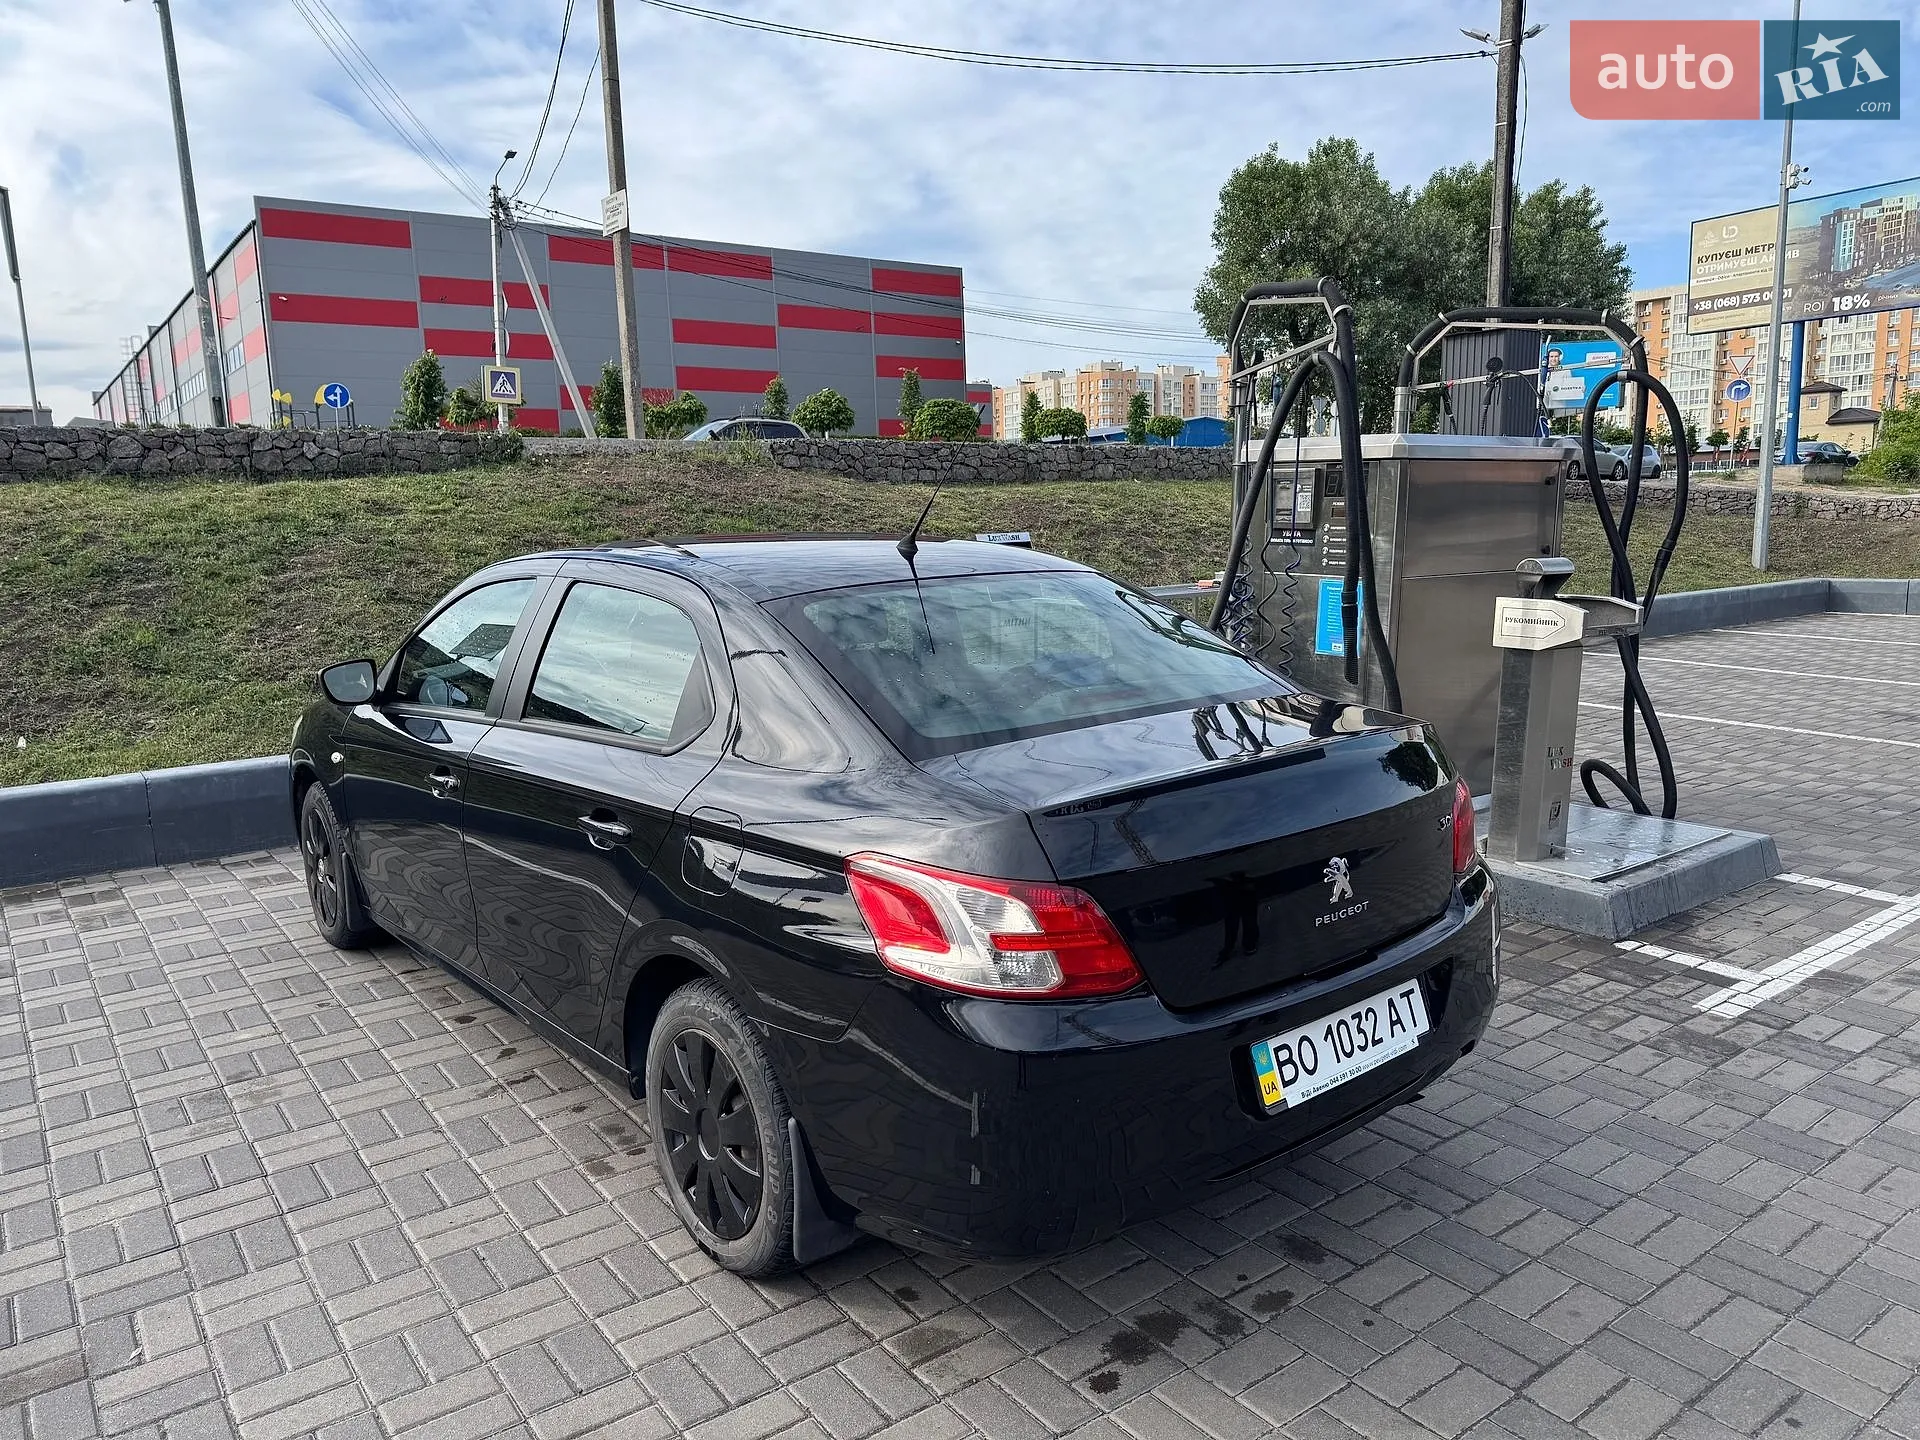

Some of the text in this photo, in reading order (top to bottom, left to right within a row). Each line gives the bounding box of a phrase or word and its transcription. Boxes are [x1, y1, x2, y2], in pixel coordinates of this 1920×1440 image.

[1696, 249, 1800, 275] ОТРИМУЄШ АКИВ
[1697, 243, 1776, 264] КУПУЄШ МЕТР
[1694, 300, 1712, 312] +38
[1713, 295, 1740, 310] (068)
[1741, 292, 1761, 304] 573
[1803, 301, 1825, 313] ROI
[1832, 293, 1871, 312] 18%
[1505, 616, 1559, 627] РУКОМИЙНИК
[1315, 901, 1370, 927] PEUGEOT
[1323, 1006, 1384, 1064] 1032
[1263, 1081, 1278, 1096] UA
[1329, 1076, 1339, 1087] 044
